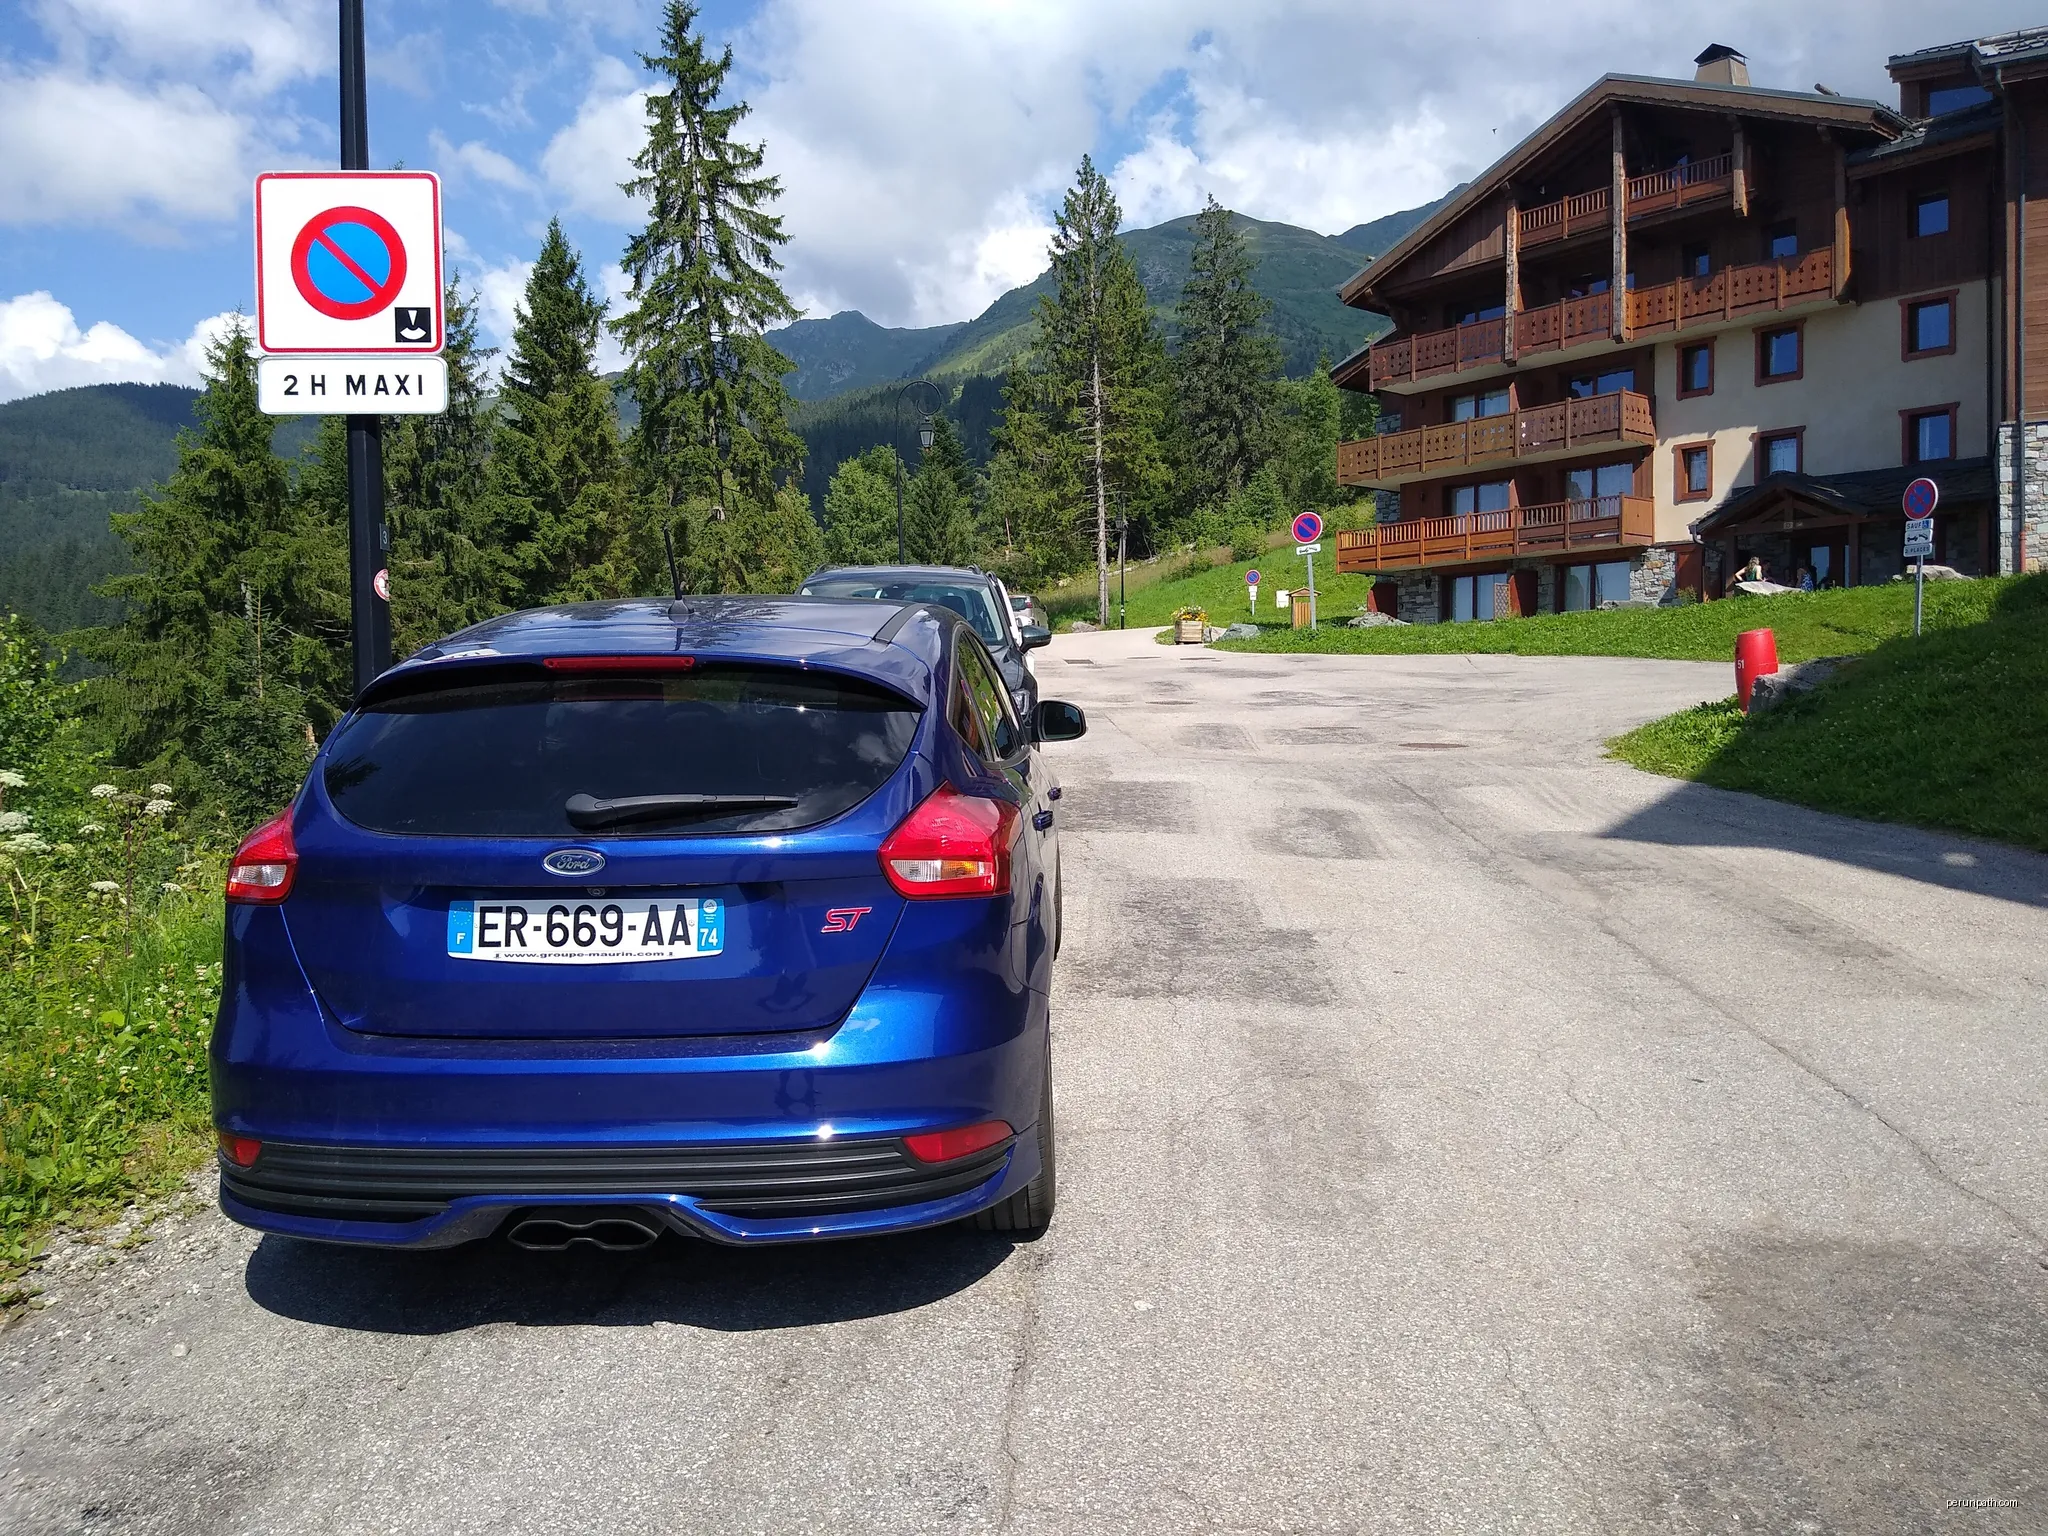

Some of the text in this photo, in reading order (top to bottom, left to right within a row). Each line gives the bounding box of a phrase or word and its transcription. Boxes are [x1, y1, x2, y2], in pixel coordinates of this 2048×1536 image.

[345, 374, 423, 396] MAXI
[1906, 521, 1922, 530] SAUF
[1737, 659, 1744, 669] 51
[556, 854, 591, 870] Ford
[478, 904, 691, 948] ER-669-AA
[820, 906, 873, 933] ST
[456, 932, 466, 945] F
[699, 927, 719, 947] 74
[503, 951, 664, 959] www.groupe-maurin.com
